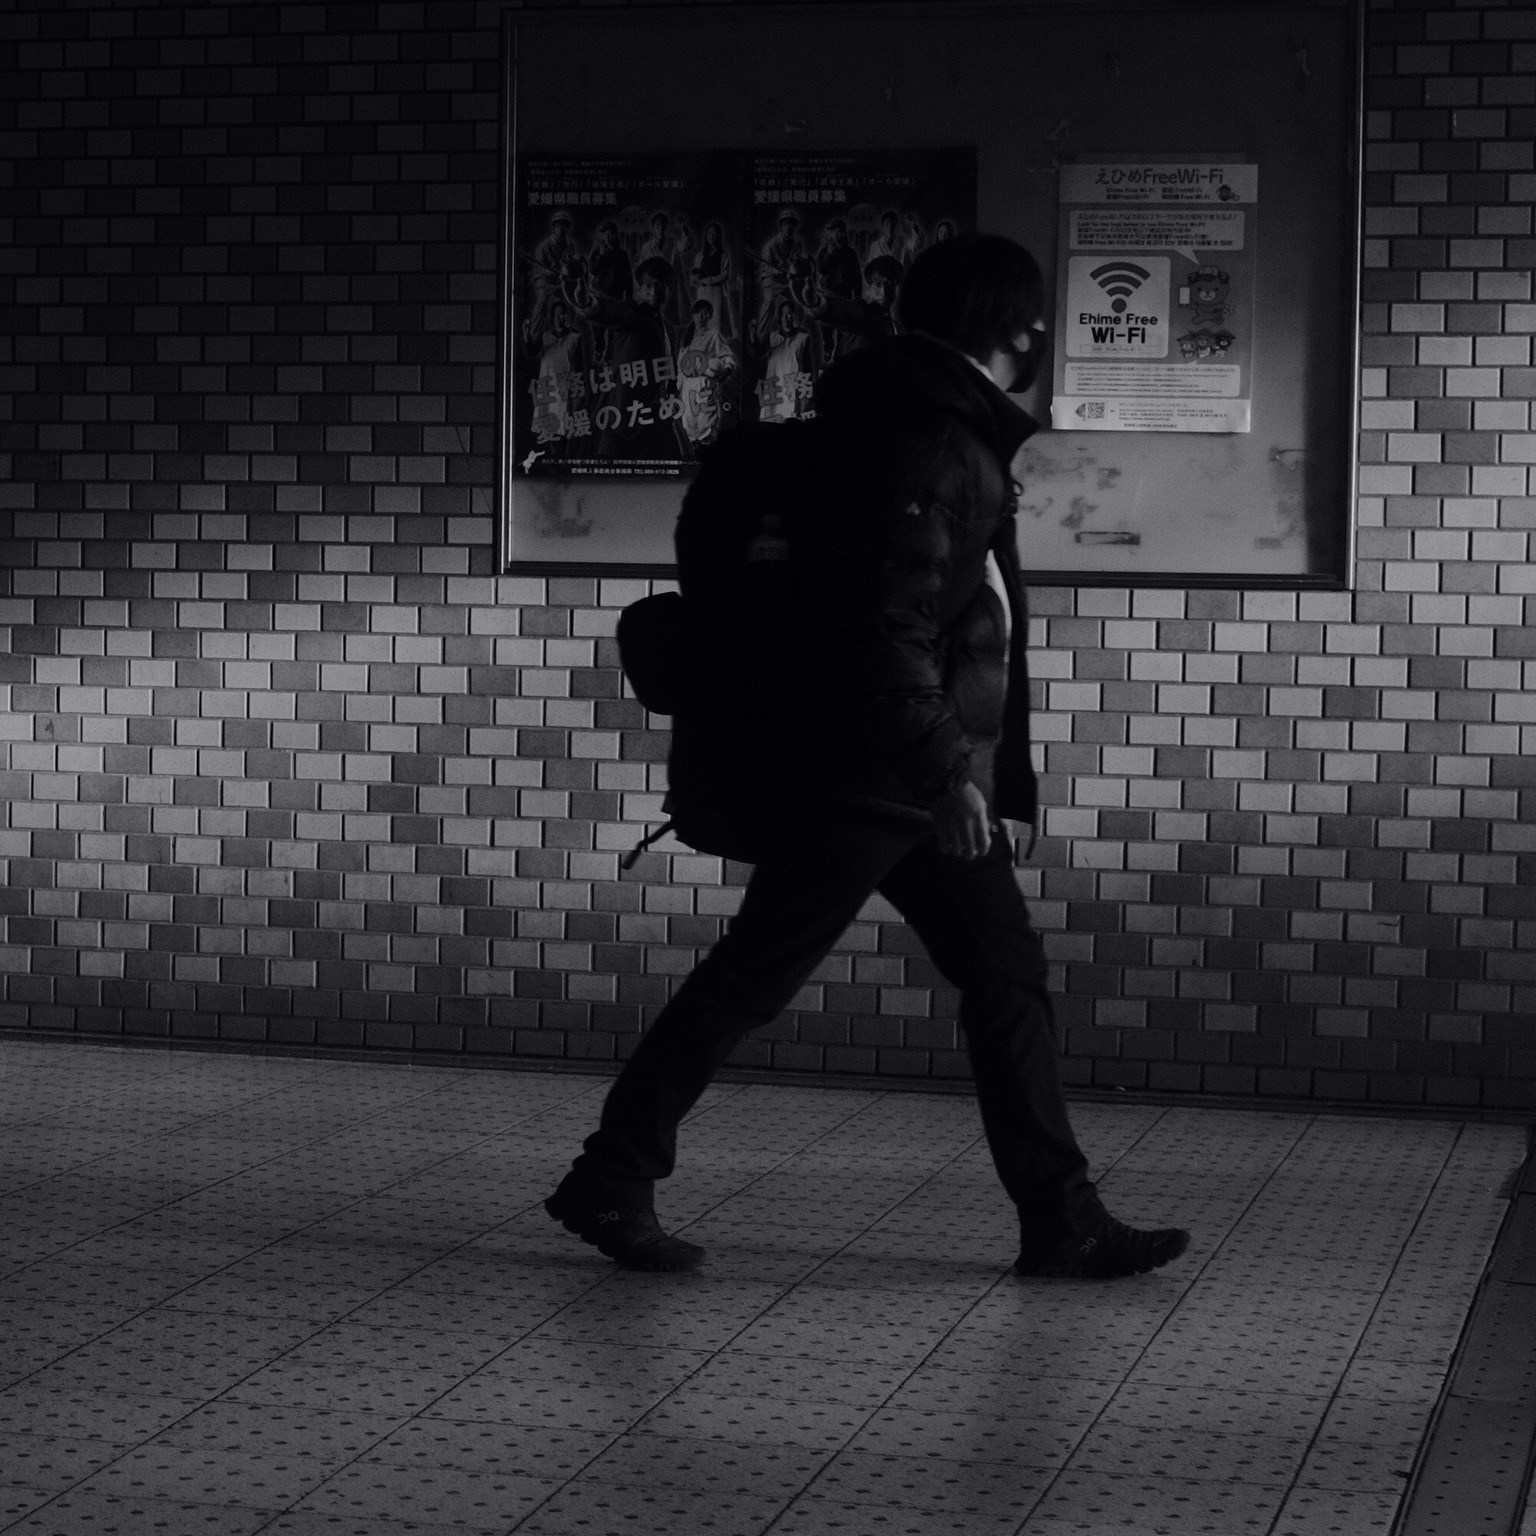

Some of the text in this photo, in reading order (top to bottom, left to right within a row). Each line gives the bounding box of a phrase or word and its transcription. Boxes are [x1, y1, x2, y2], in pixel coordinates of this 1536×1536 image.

[1095, 168, 1224, 185] えひめFreeWi-Fi
[1079, 313, 1158, 325] Ehime Free
[1091, 326, 1146, 343] Wi-Fi
